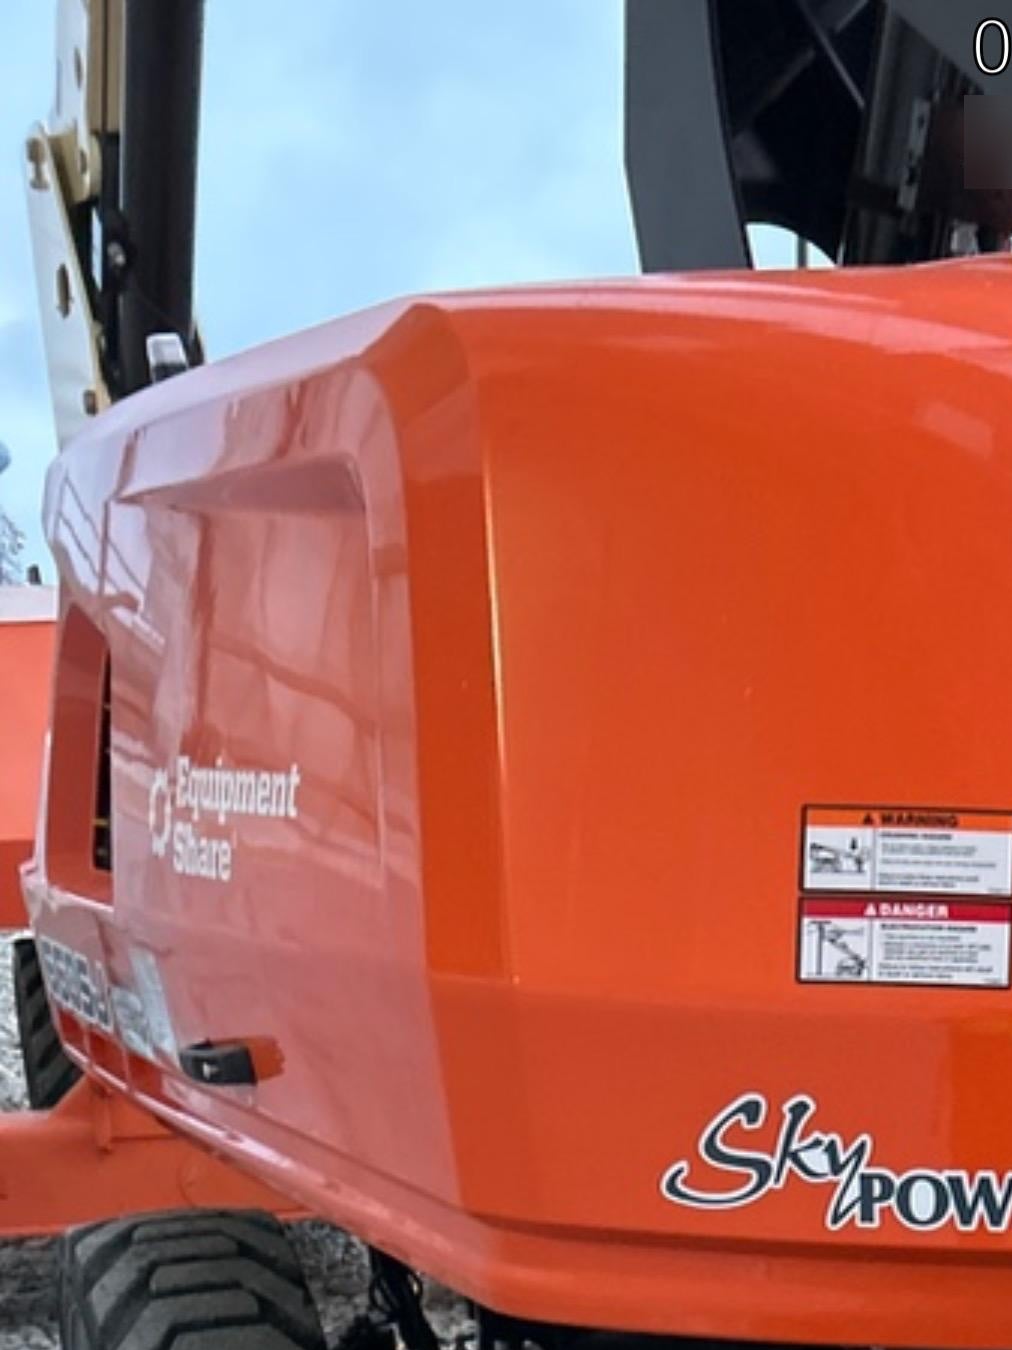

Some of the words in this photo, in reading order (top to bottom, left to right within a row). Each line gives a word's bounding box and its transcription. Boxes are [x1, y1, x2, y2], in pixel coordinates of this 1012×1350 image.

[176, 755, 300, 825] Equipment
[880, 811, 958, 828] WARNING
[172, 821, 231, 881] Share
[878, 902, 949, 919] DANGER
